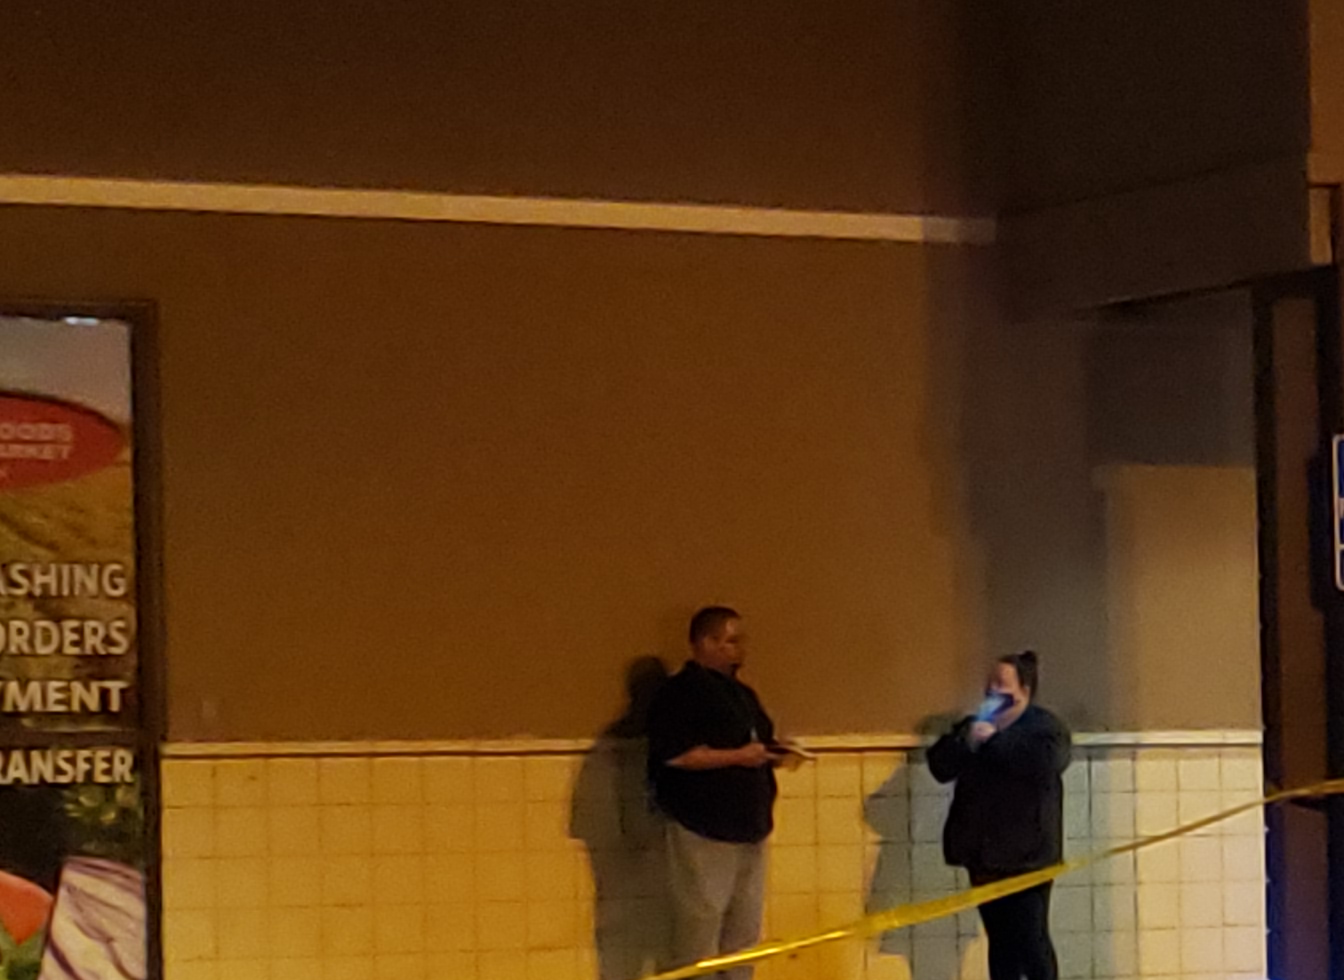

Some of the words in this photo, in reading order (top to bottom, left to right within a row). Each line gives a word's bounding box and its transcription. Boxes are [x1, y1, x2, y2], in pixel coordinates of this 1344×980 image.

[0, 563, 126, 597] SHING
[0, 620, 130, 655] RDERS
[0, 680, 129, 712] MENT
